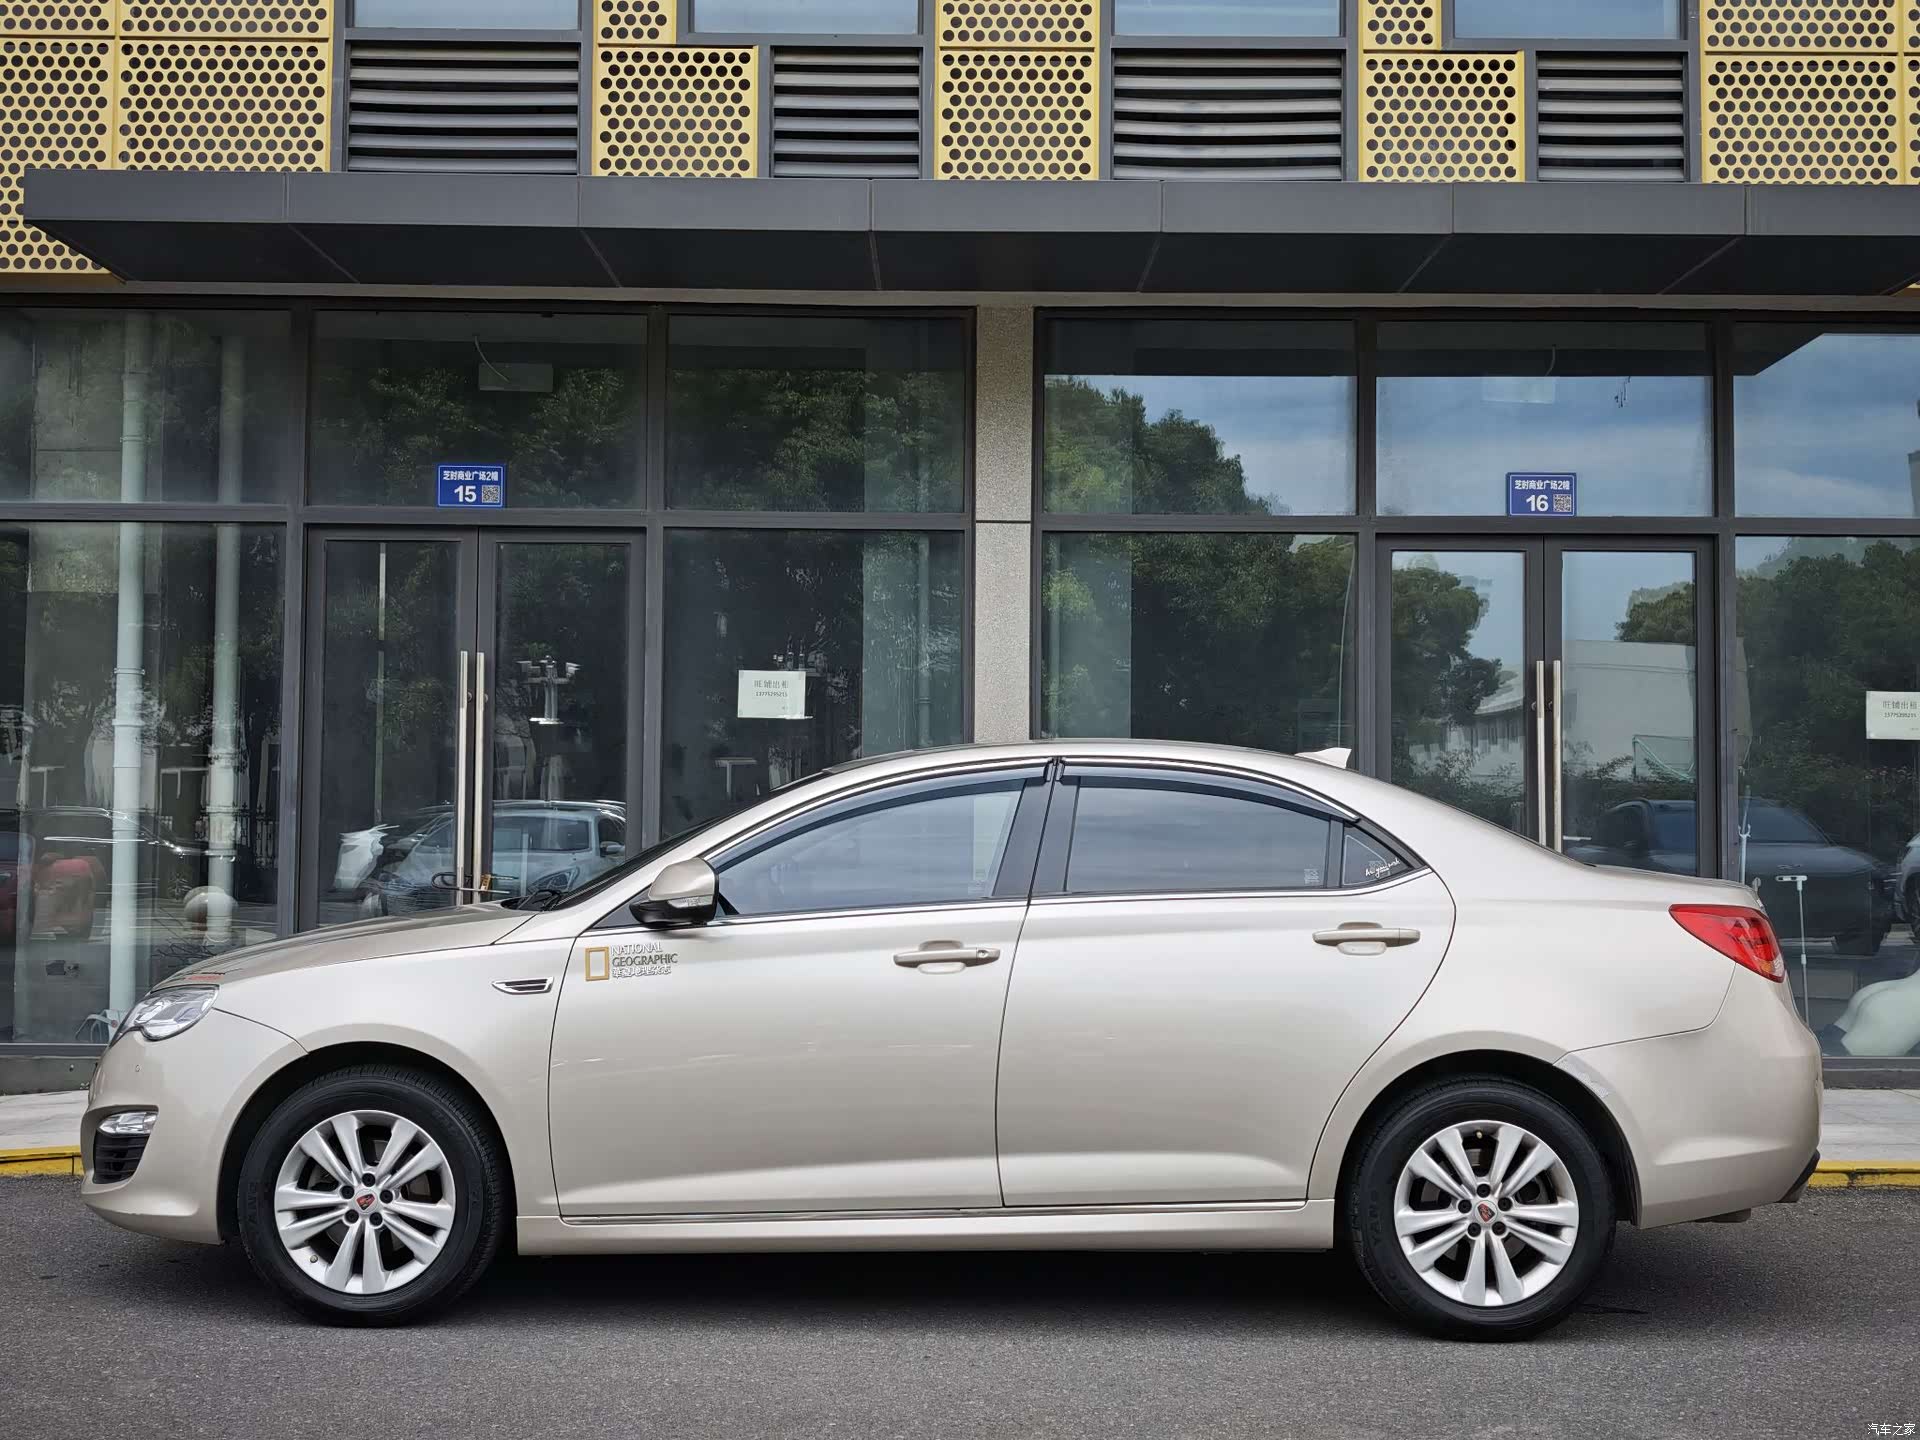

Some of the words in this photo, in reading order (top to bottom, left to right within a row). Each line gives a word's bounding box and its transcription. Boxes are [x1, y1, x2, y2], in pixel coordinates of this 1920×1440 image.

[454, 485, 477, 503] 15
[1526, 494, 1549, 512] 16
[611, 942, 663, 957] NATIONAL
[612, 953, 679, 968] GEOGRAPHIC
